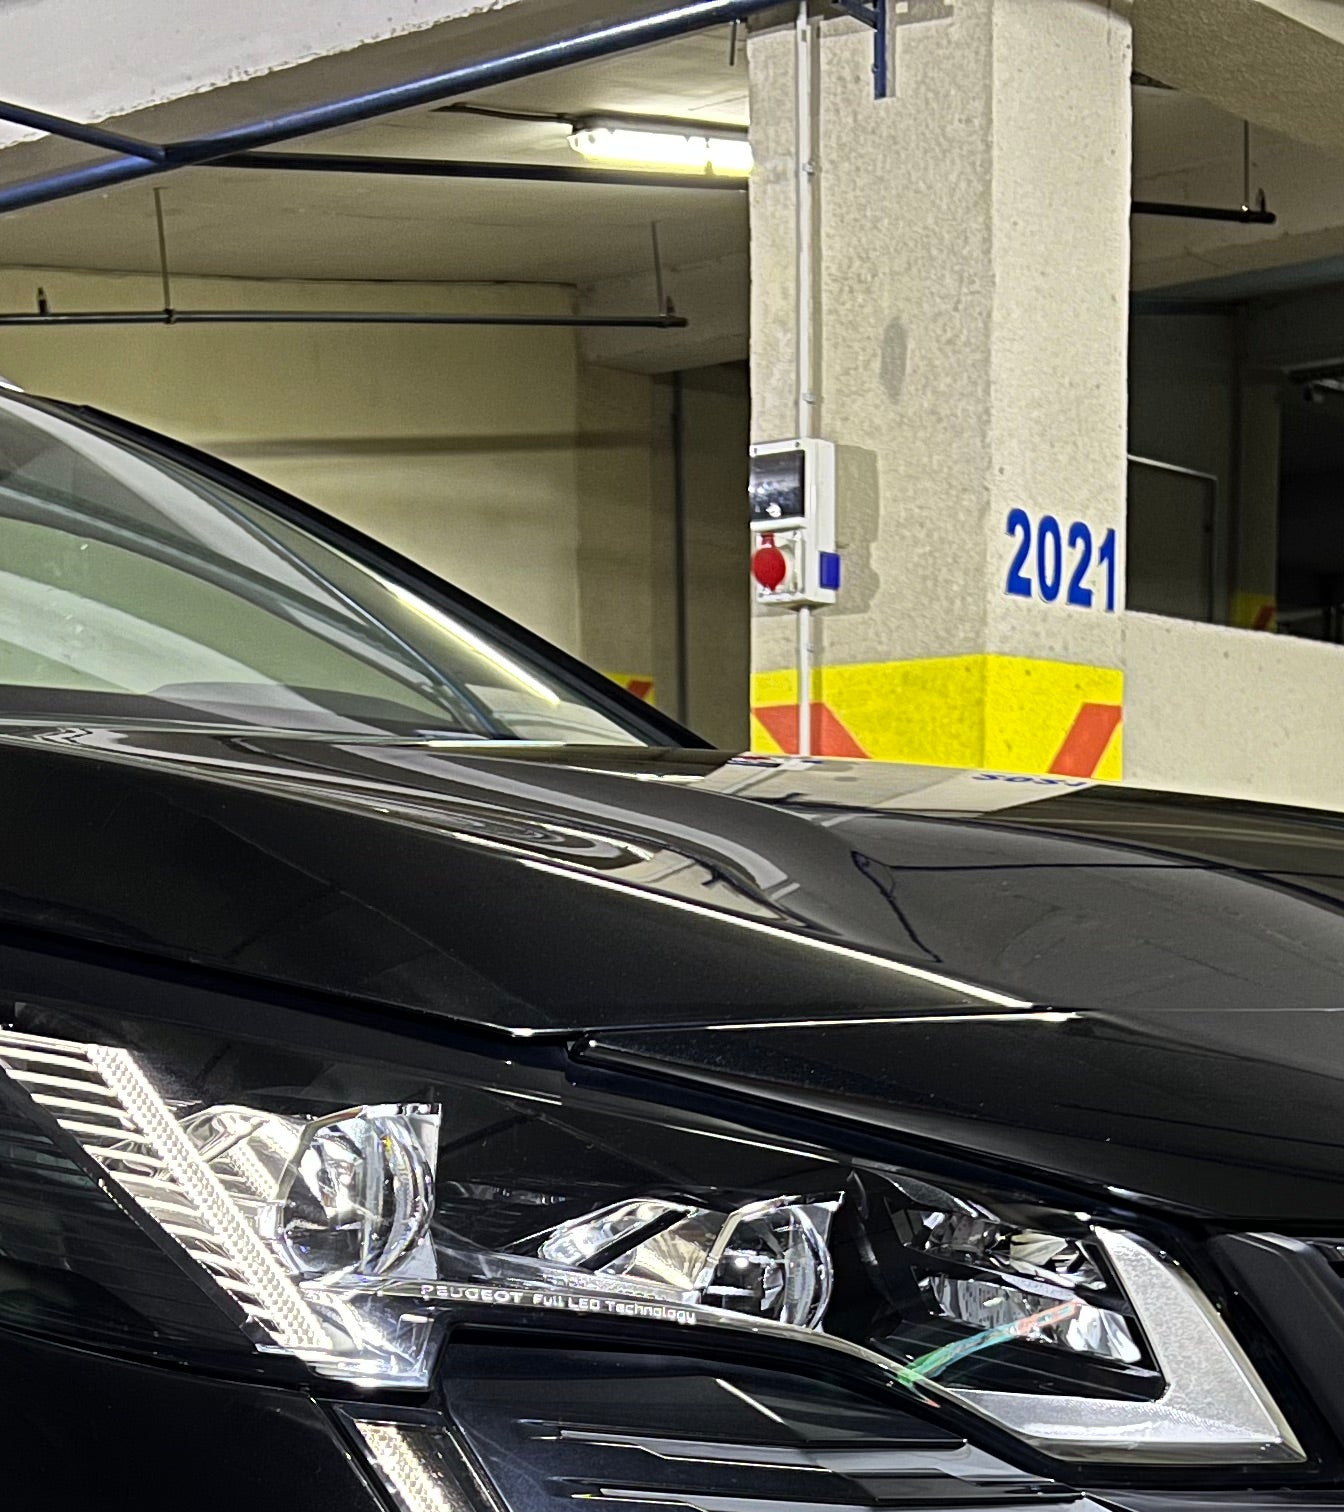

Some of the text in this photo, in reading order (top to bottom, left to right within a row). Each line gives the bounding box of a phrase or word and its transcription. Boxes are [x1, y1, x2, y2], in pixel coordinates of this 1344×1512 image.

[1005, 507, 1117, 613] 2021
[420, 1284, 697, 1325] PEUGEOT Full LED Technology
